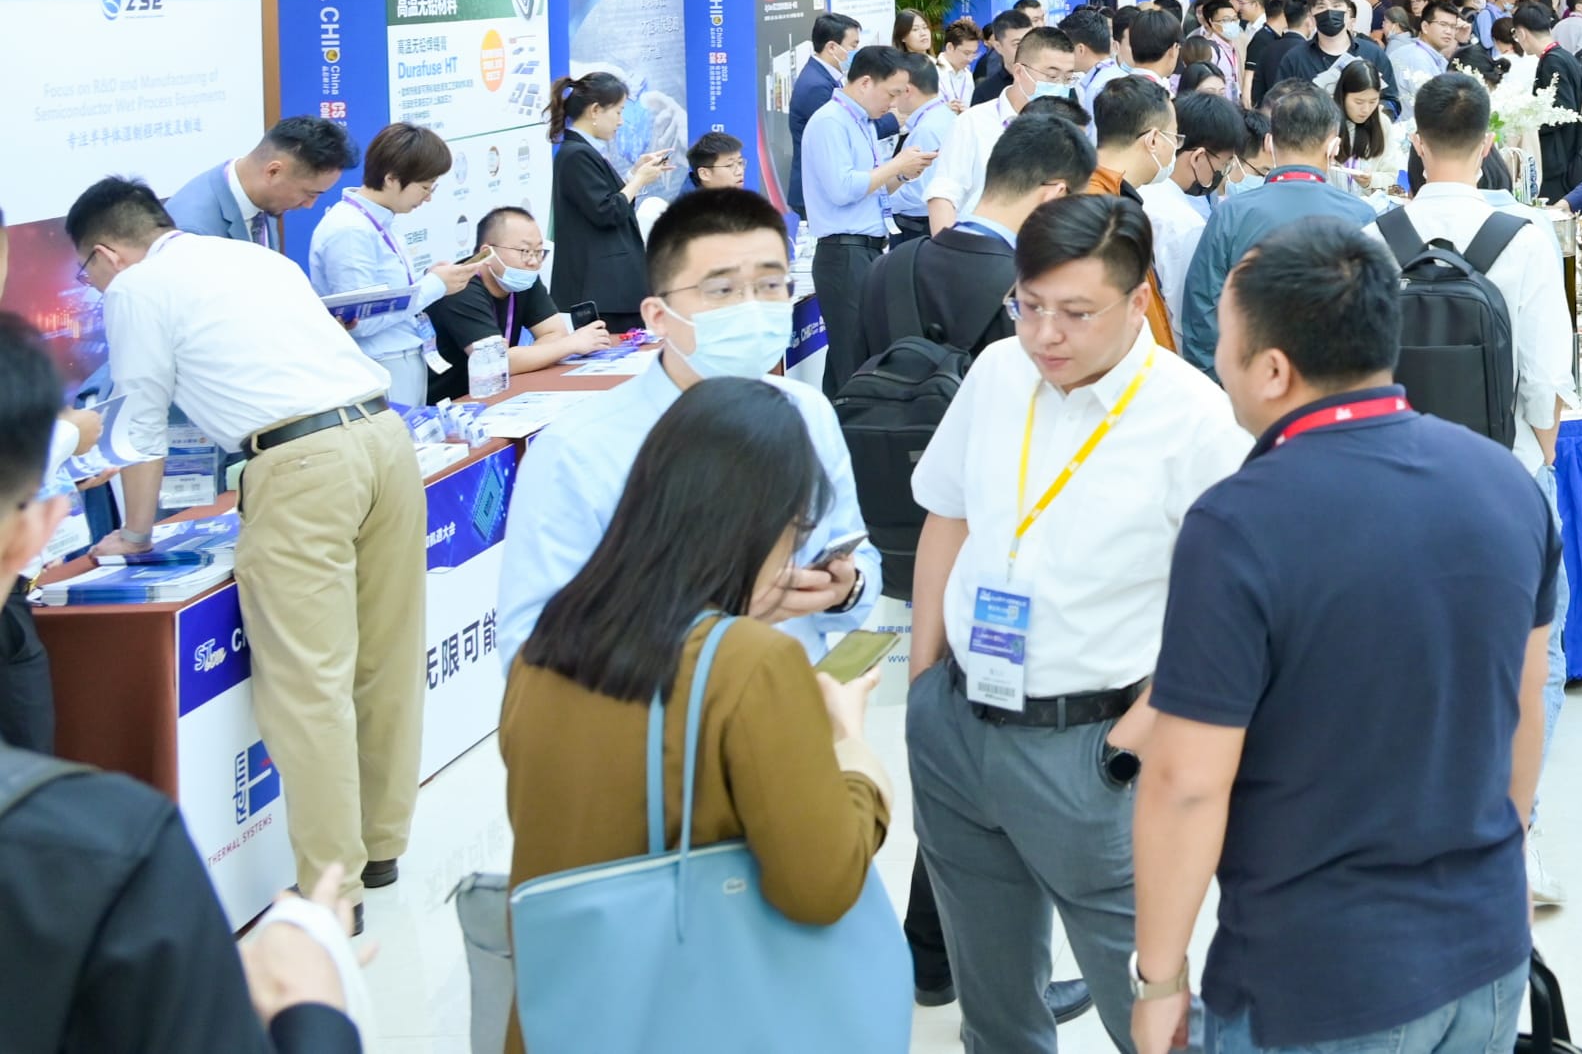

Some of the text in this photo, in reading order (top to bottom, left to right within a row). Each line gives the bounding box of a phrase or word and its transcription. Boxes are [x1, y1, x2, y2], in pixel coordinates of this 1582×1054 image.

[320, 7, 340, 64] CHIP
[445, 57, 458, 74] HT
[208, 813, 273, 868] THERMAL SYSTEMS
